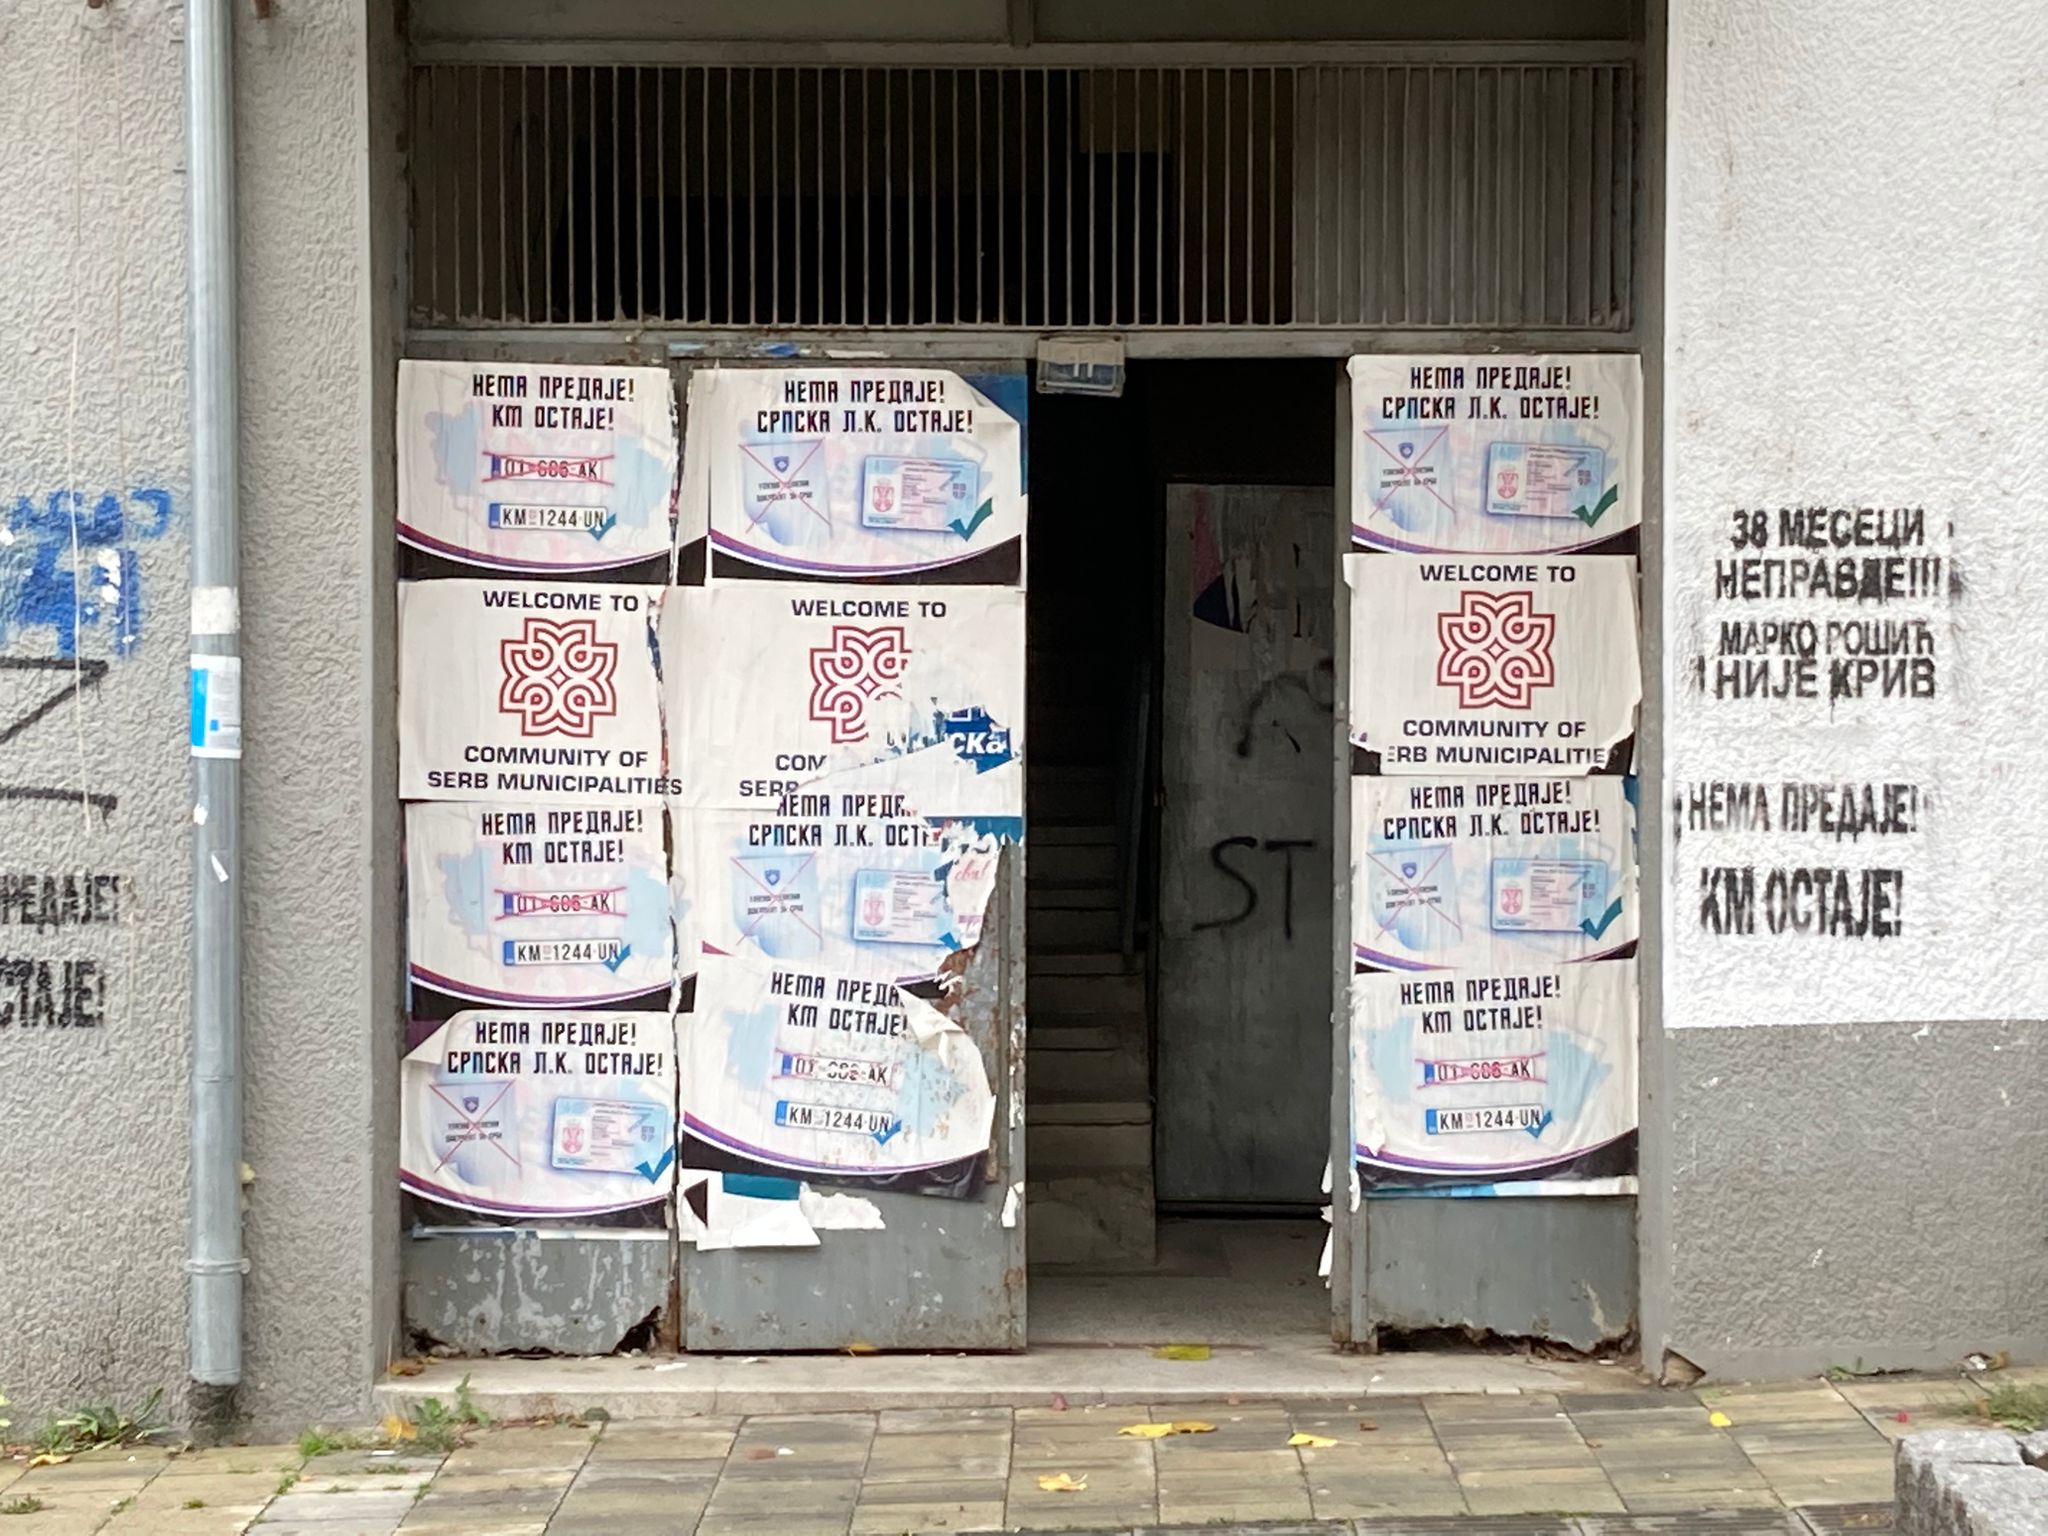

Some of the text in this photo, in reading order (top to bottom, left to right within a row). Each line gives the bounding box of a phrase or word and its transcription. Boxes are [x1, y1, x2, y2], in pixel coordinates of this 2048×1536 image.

[472, 374, 635, 402] НЕМА ПРЕДАЈЕ!
[1411, 366, 1571, 391] НЕМА ПРЕДАЈЕ!
[785, 380, 945, 405] НЕМА ПРЕДАЈЕ!
[535, 406, 614, 430] ОСТАЈЕ!
[1382, 396, 1599, 419] СРПСКА Л.К. ОСТАЈЕ!
[757, 409, 973, 434] СРПСКА Л.К. ОСТАЈЕ!
[1730, 505, 1925, 549] 38 МЕСЕЦИ
[1420, 564, 1576, 582] WELCOME TO
[483, 590, 639, 612] WELCOME TO
[792, 599, 947, 618] WELCOME TO
[1720, 619, 1818, 658] МАРКО
[1716, 657, 1936, 700] НИЈЕ КРИВ
[1403, 719, 1587, 738] COMMUNITY OF
[464, 745, 649, 767] COMMUNITY OF
[428, 771, 683, 795] SERB MUNICIPALITIES
[1411, 780, 1571, 809] НЕМА ПРЕДАЈЕ!
[482, 810, 643, 836] НЕМА ПРЕДАЈЕ!
[1688, 780, 1919, 843] НЕМА ПРЕДАЈЕ!
[749, 824, 822, 847] СРПСКА
[834, 824, 874, 847] Л.К.
[1384, 809, 1600, 840] СРПСКА Л.К. ОСТАЈЕ!
[545, 840, 624, 864] ОСТАЈЕ!
[1701, 866, 1903, 939] КМ ОСТАЈЕ!
[771, 972, 826, 999] НЕМА
[1401, 975, 1561, 1006] НЕМА ПРЕДАЈЕ!
[1464, 1005, 1542, 1031] ОСТАЈЕ!
[475, 1021, 637, 1047] НЕМА ПРЕДАЈЕ!
[447, 1051, 663, 1076] СРПСКА Л.К. ОСТАЈЕ!
